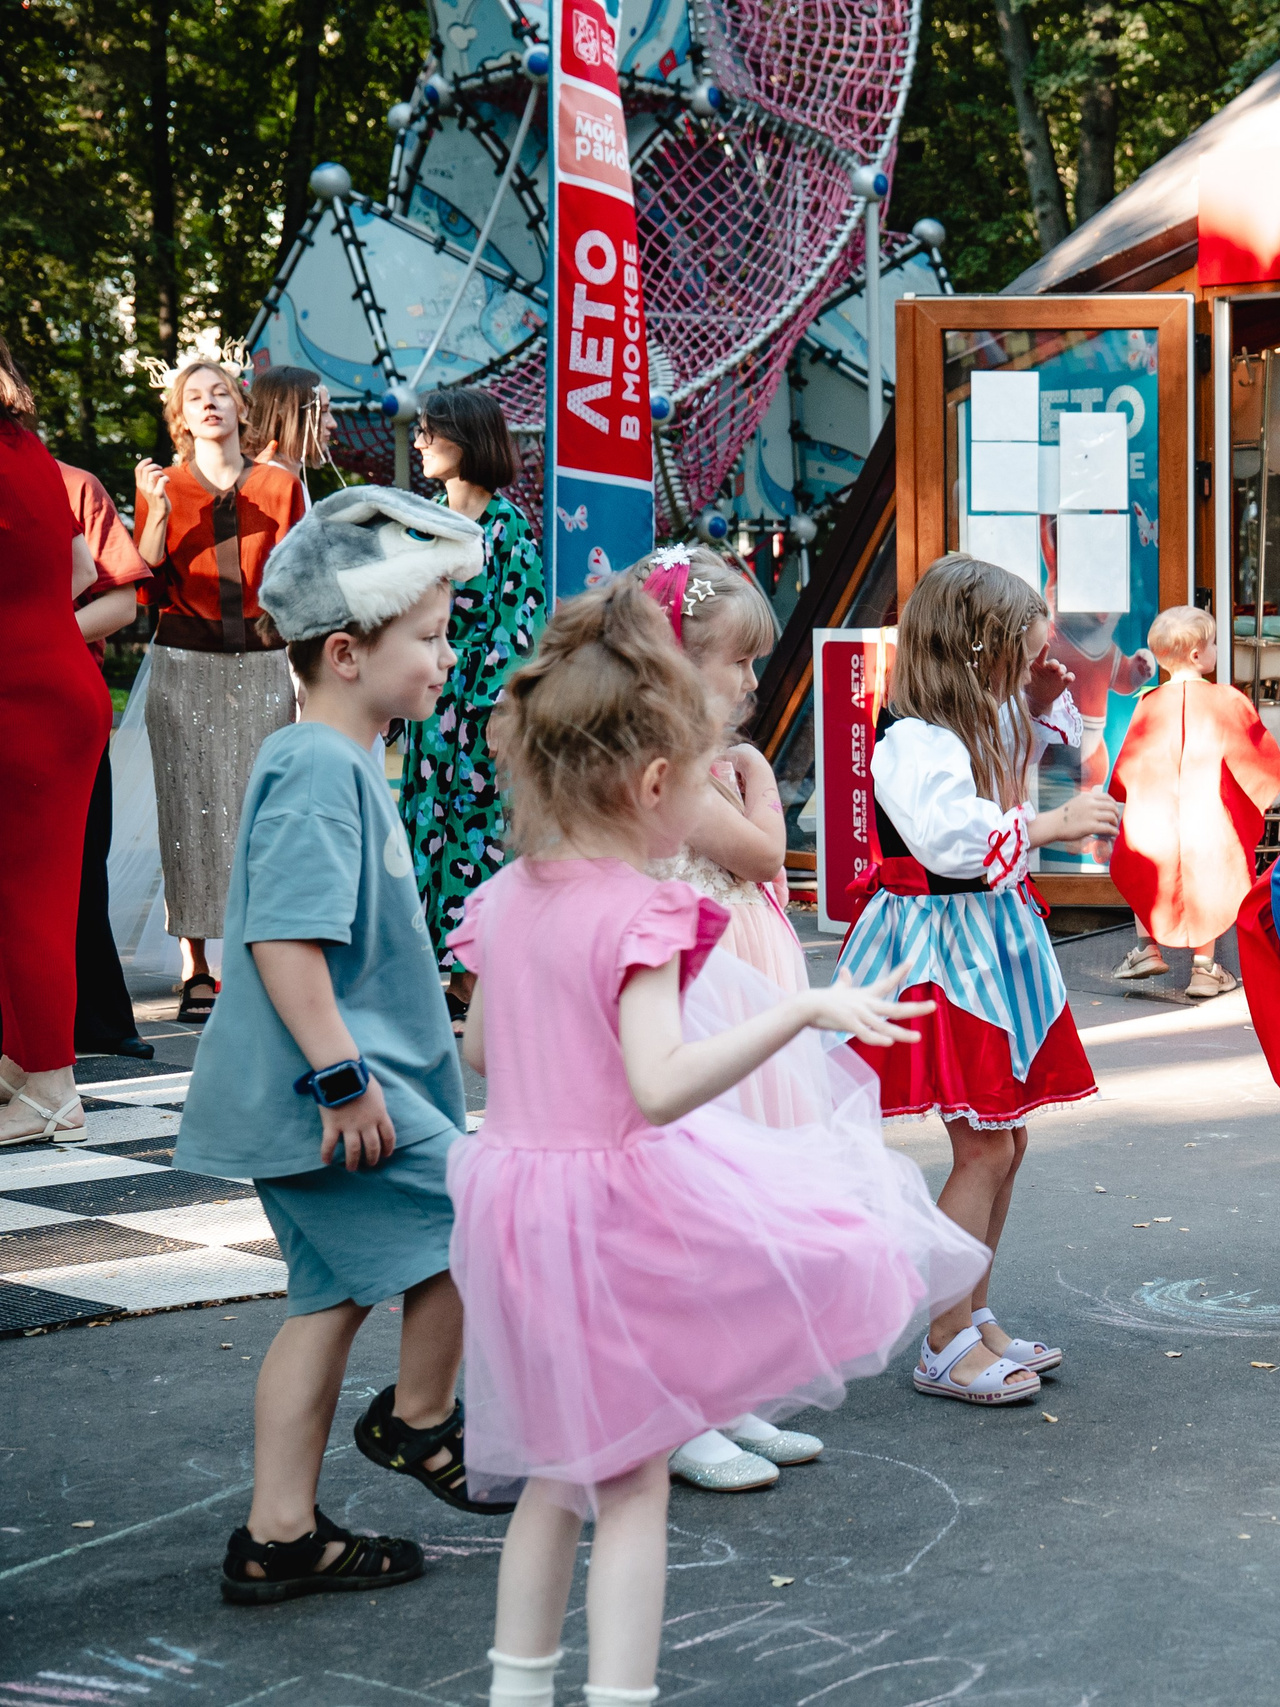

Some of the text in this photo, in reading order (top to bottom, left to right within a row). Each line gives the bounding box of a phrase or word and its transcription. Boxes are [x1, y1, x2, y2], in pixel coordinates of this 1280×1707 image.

[567, 229, 617, 435] ЛЕТО
[620, 240, 640, 441] В МОСКВЕ
[851, 653, 860, 708] ЛЕТО
[851, 723, 861, 777] ЛЕТО
[852, 788, 862, 843] ЛЕТО
